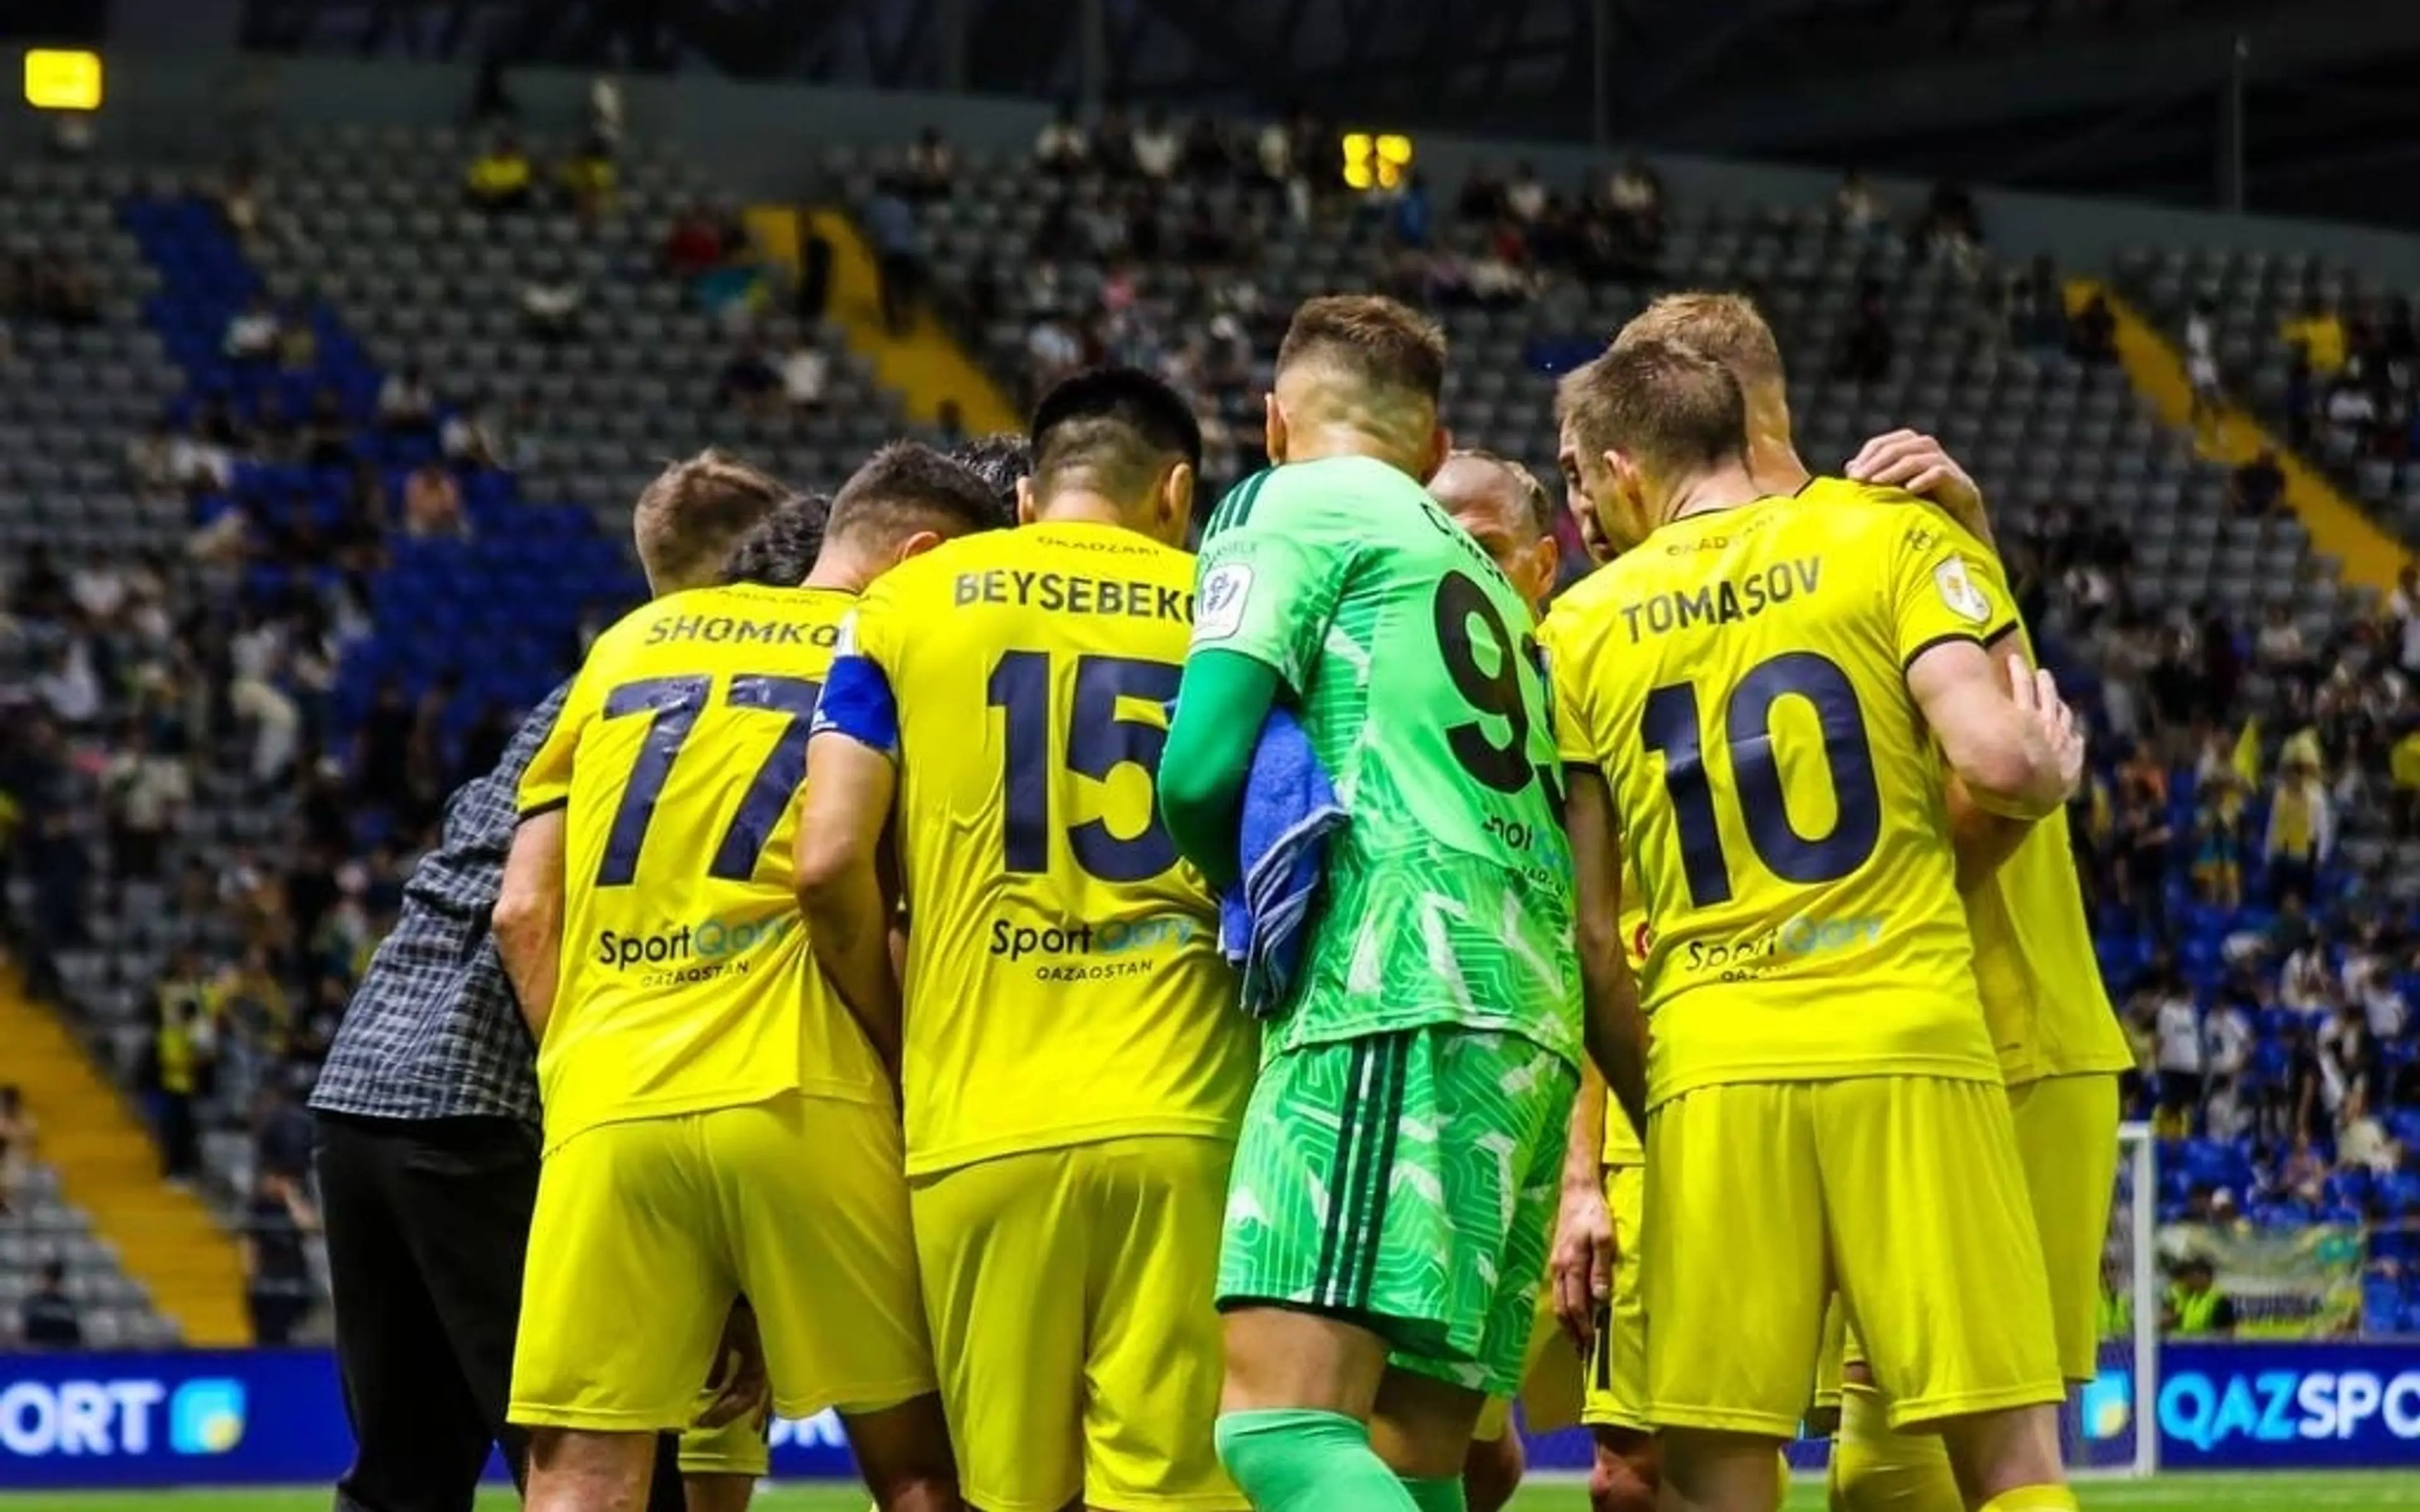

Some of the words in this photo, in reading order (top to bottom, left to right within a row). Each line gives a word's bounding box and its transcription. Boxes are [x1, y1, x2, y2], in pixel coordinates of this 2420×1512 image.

[645, 614, 838, 649] SHOMKO
[1621, 556, 1821, 644] TOMASOV
[596, 674, 822, 887] 77
[988, 649, 1185, 884] 15
[1640, 651, 1881, 908] 10
[600, 916, 788, 971] SportQo
